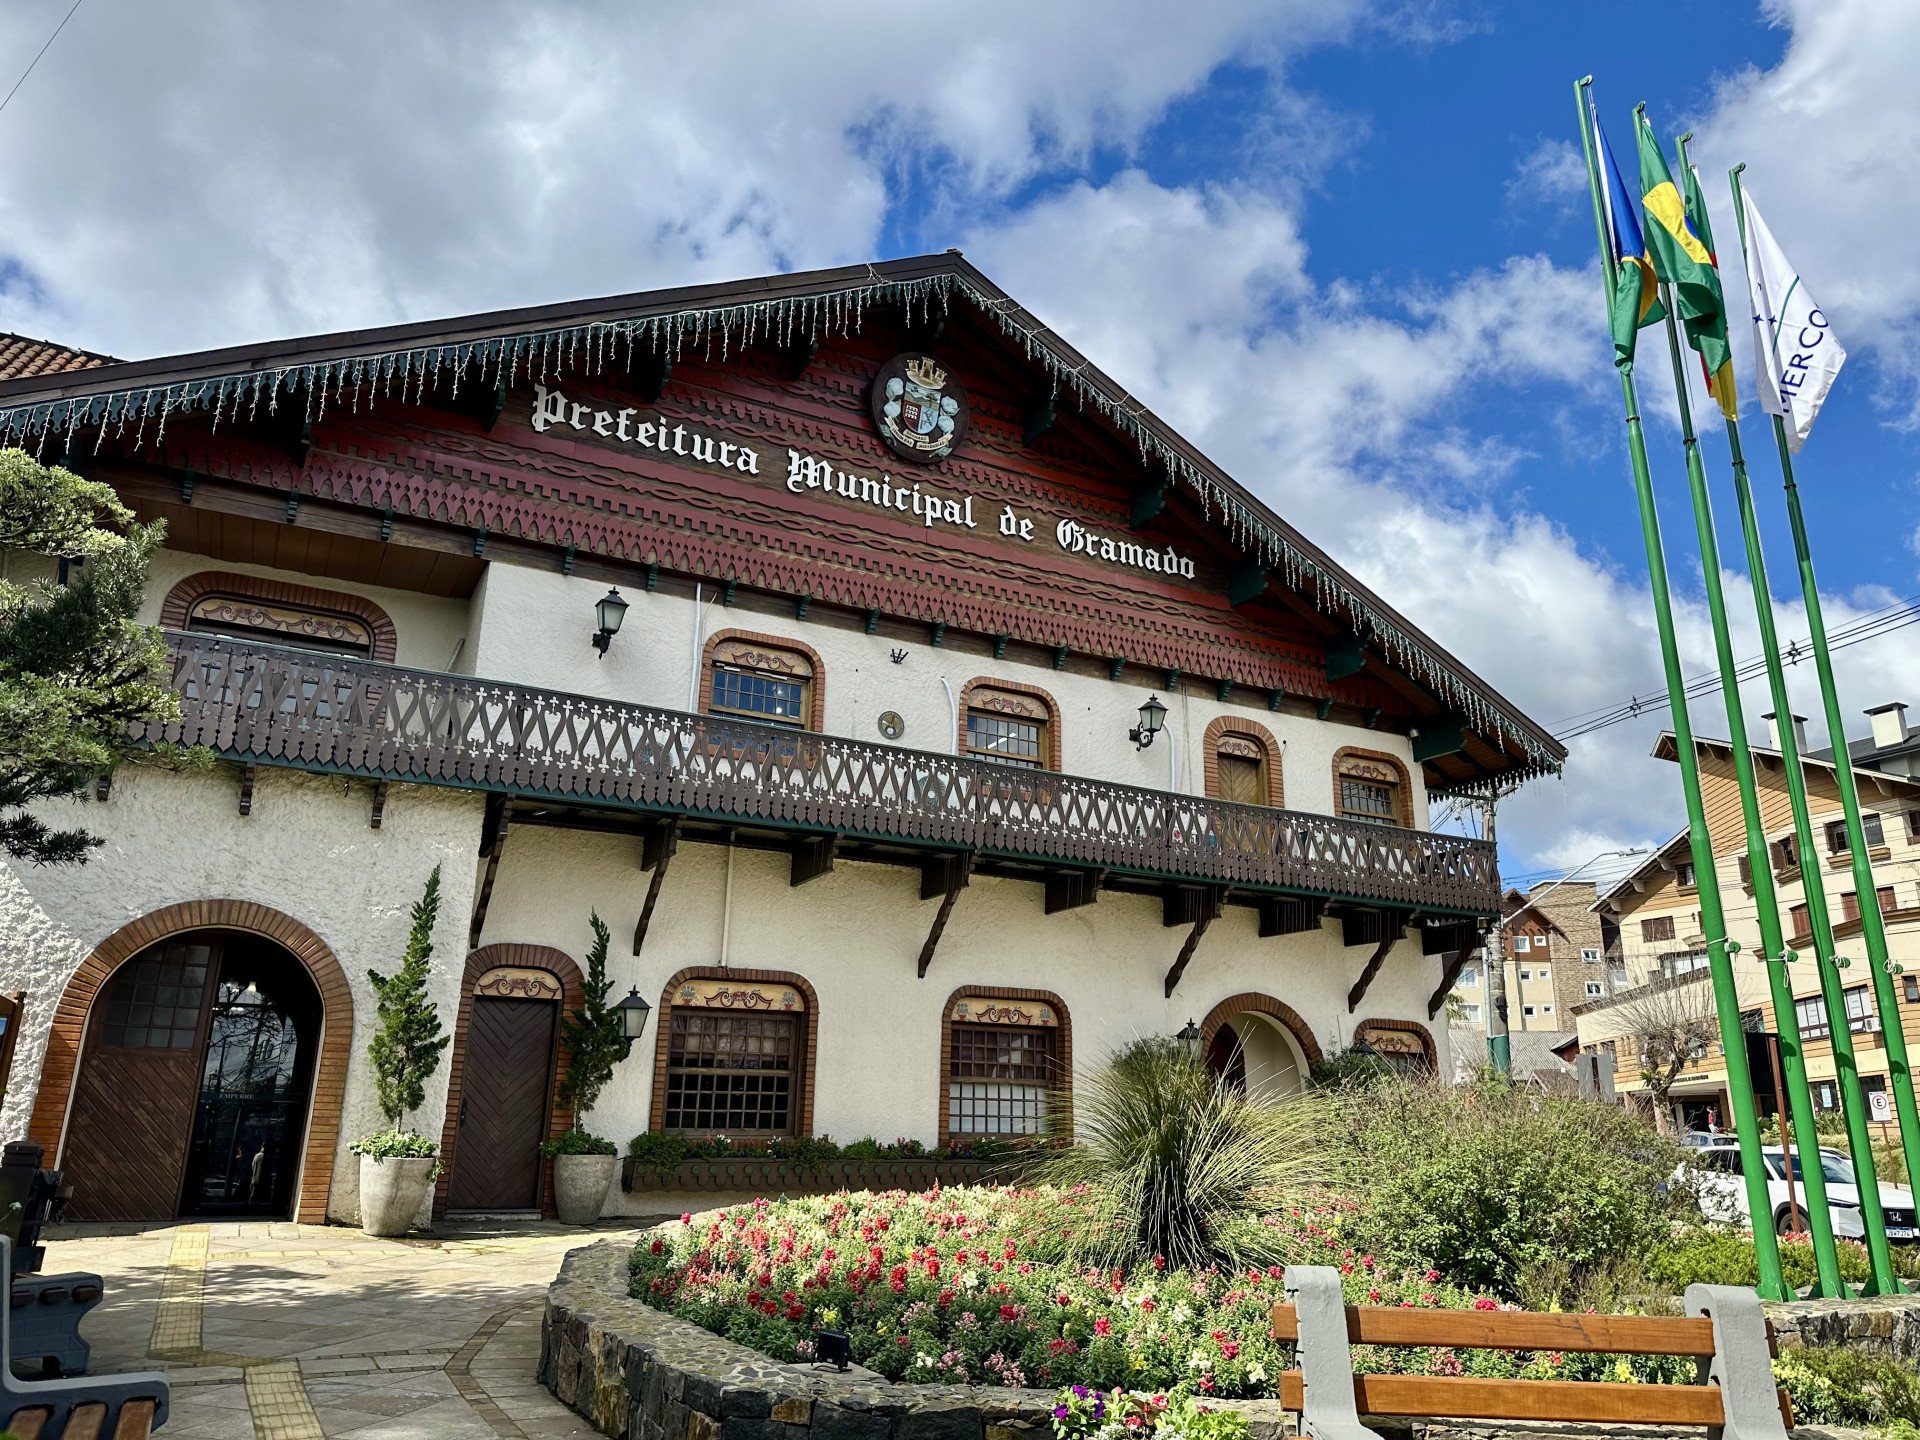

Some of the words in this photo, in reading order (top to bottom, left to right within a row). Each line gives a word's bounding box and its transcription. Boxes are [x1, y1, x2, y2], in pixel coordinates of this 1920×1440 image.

[531, 383, 760, 475] Prefeitura
[786, 448, 978, 528] Municipal
[999, 505, 1035, 541] de
[1056, 518, 1195, 580] Gramado
[1876, 1098, 1883, 1107] E
